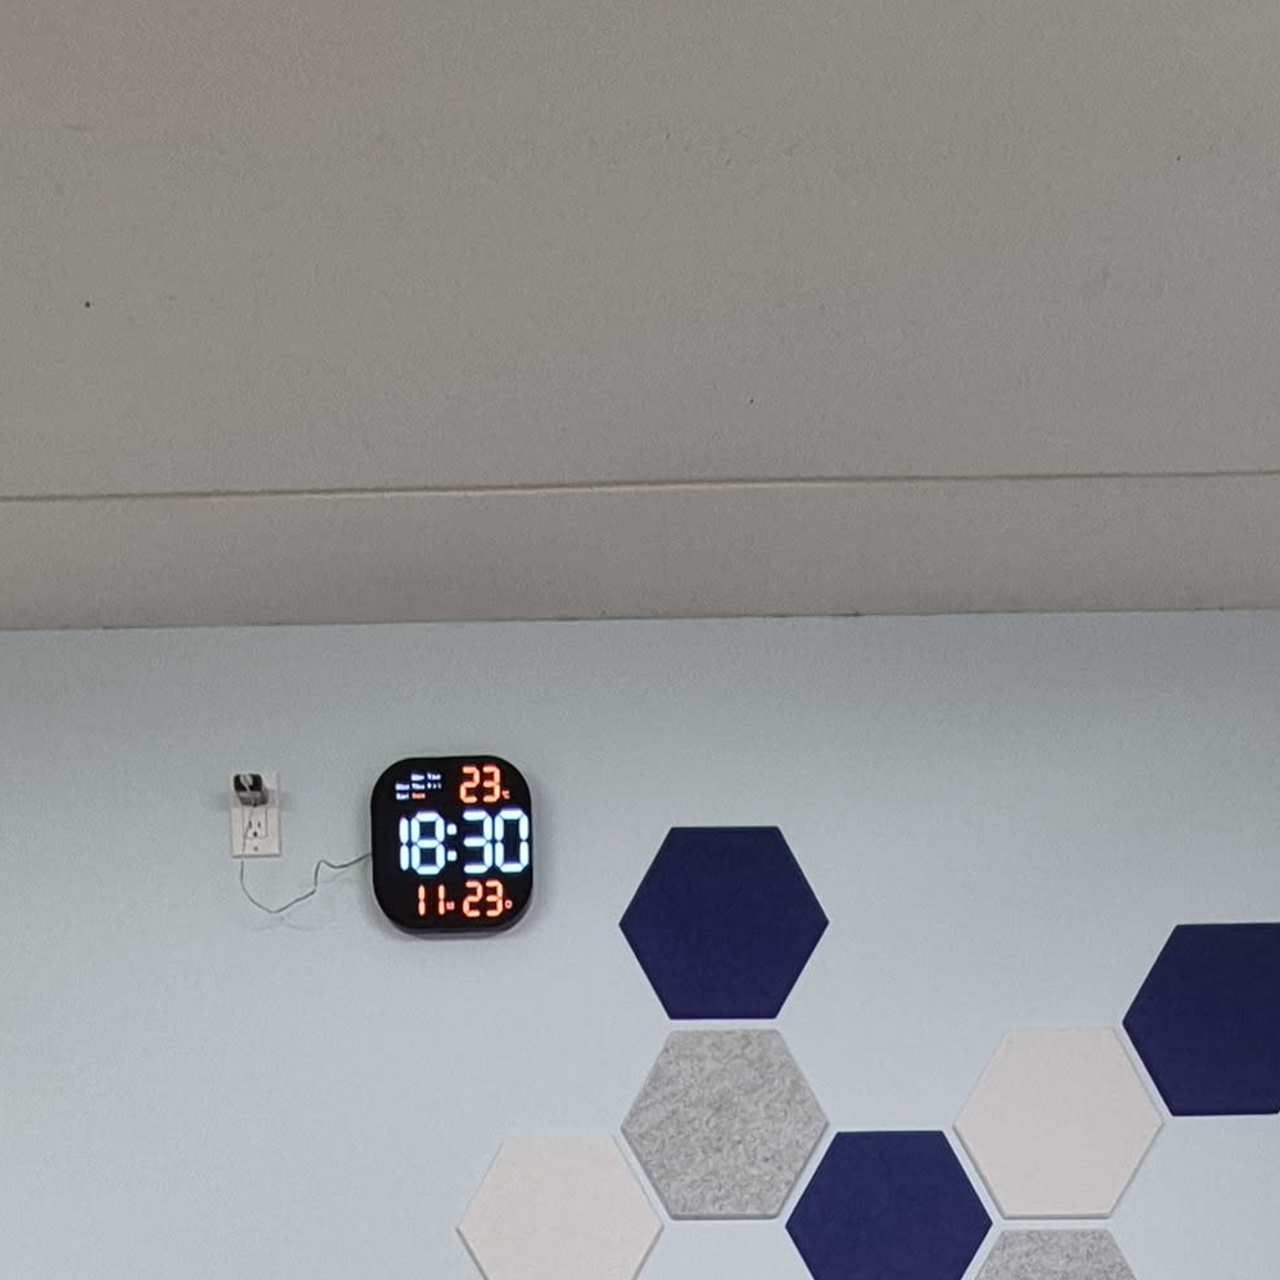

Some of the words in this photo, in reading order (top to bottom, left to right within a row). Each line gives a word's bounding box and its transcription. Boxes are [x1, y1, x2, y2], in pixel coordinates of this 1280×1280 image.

[460, 766, 501, 803] 23
[400, 809, 529, 875] 18:30
[462, 879, 504, 918] 23
